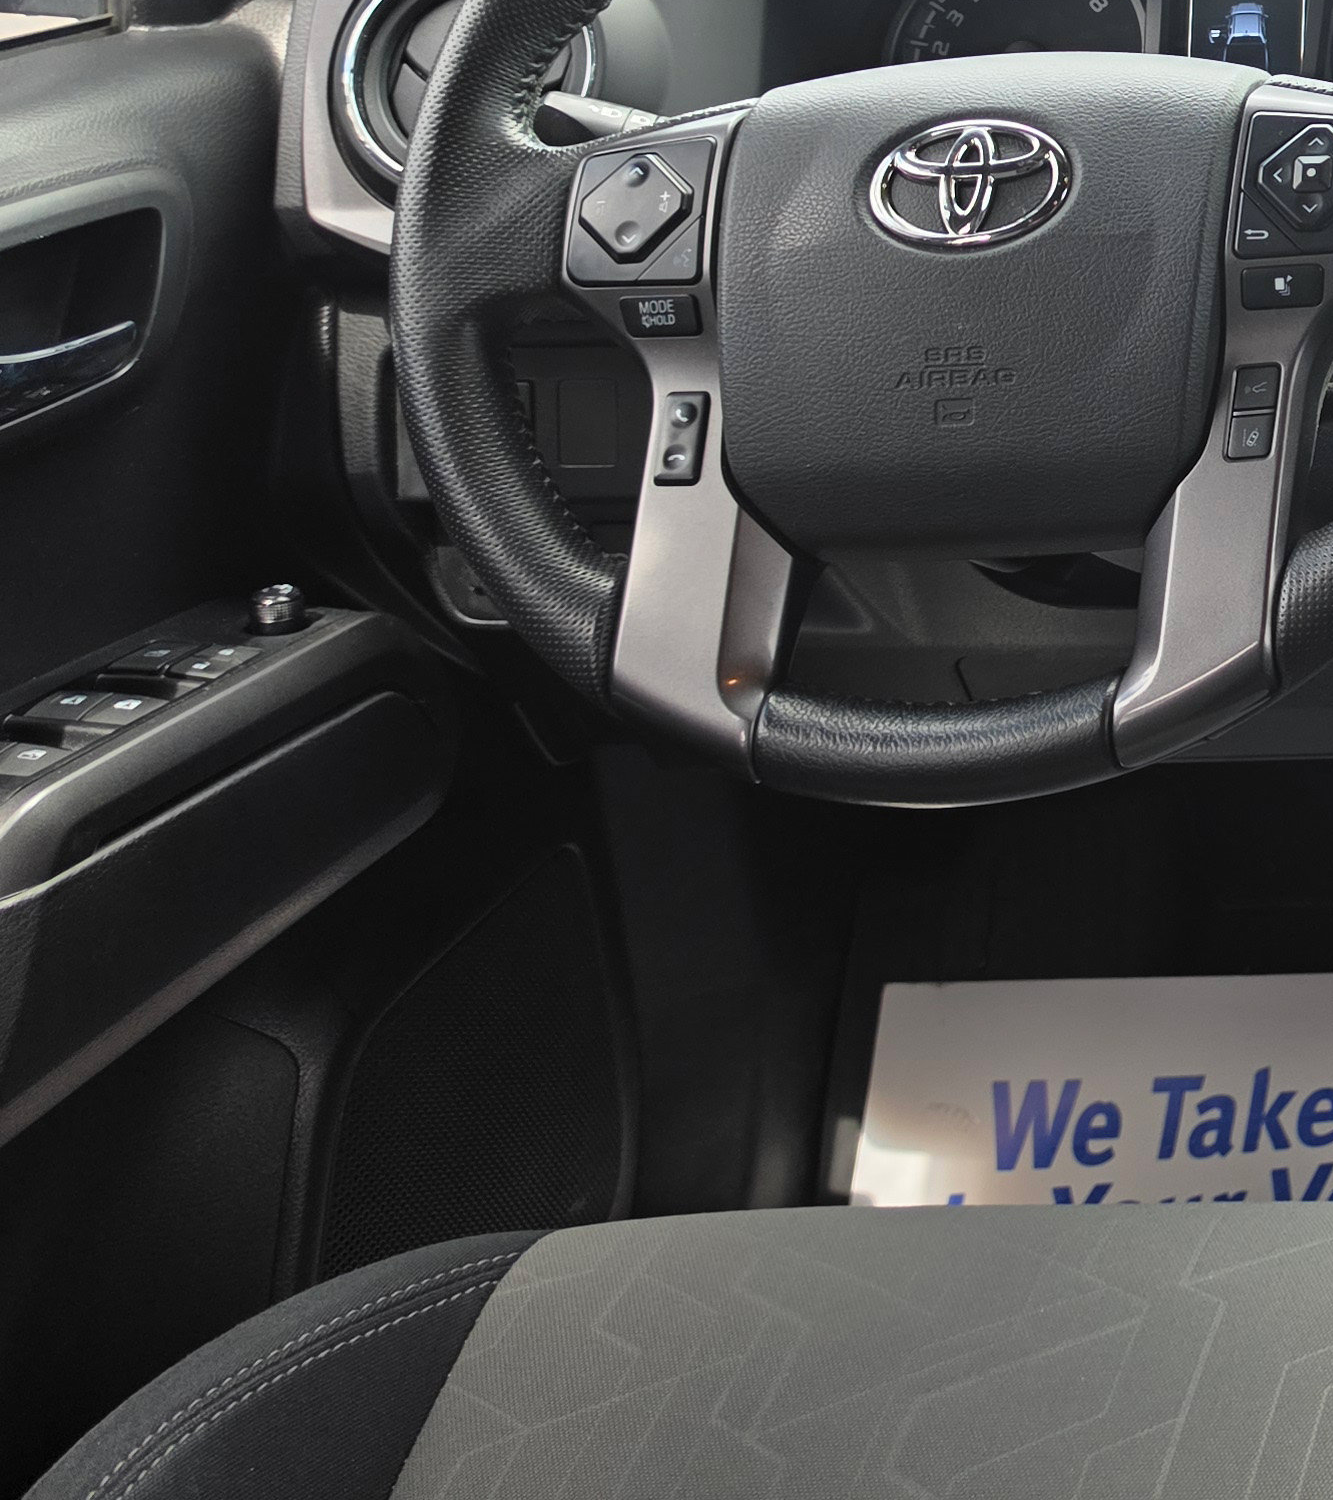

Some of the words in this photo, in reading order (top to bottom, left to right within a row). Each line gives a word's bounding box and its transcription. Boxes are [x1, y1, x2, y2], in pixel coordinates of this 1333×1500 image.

[946, 9, 965, 27] 3
[932, 40, 950, 56] 2
[638, 299, 675, 314] MODE
[651, 314, 676, 326] HOLD
[924, 346, 986, 362] SRS
[894, 367, 1017, 390] AIRBAG
[990, 1078, 1121, 1172] We
